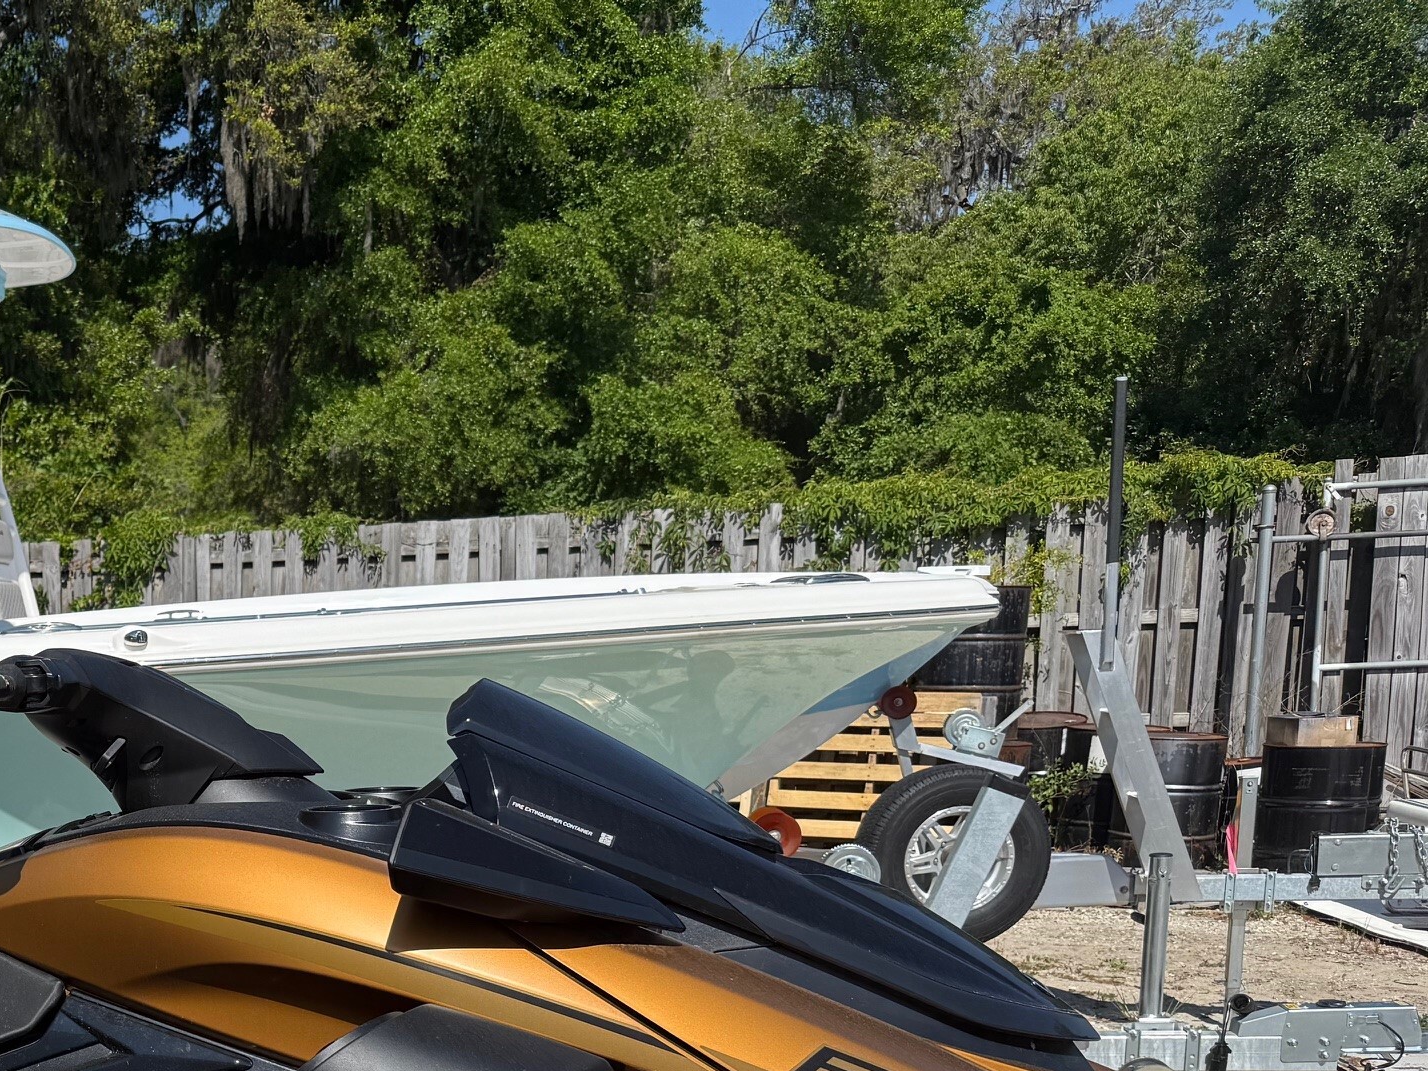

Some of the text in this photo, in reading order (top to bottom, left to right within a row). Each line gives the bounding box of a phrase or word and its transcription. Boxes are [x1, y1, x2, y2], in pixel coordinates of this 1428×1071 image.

[512, 801, 593, 837] FIRE EXTINGUISHER CONTAINER
